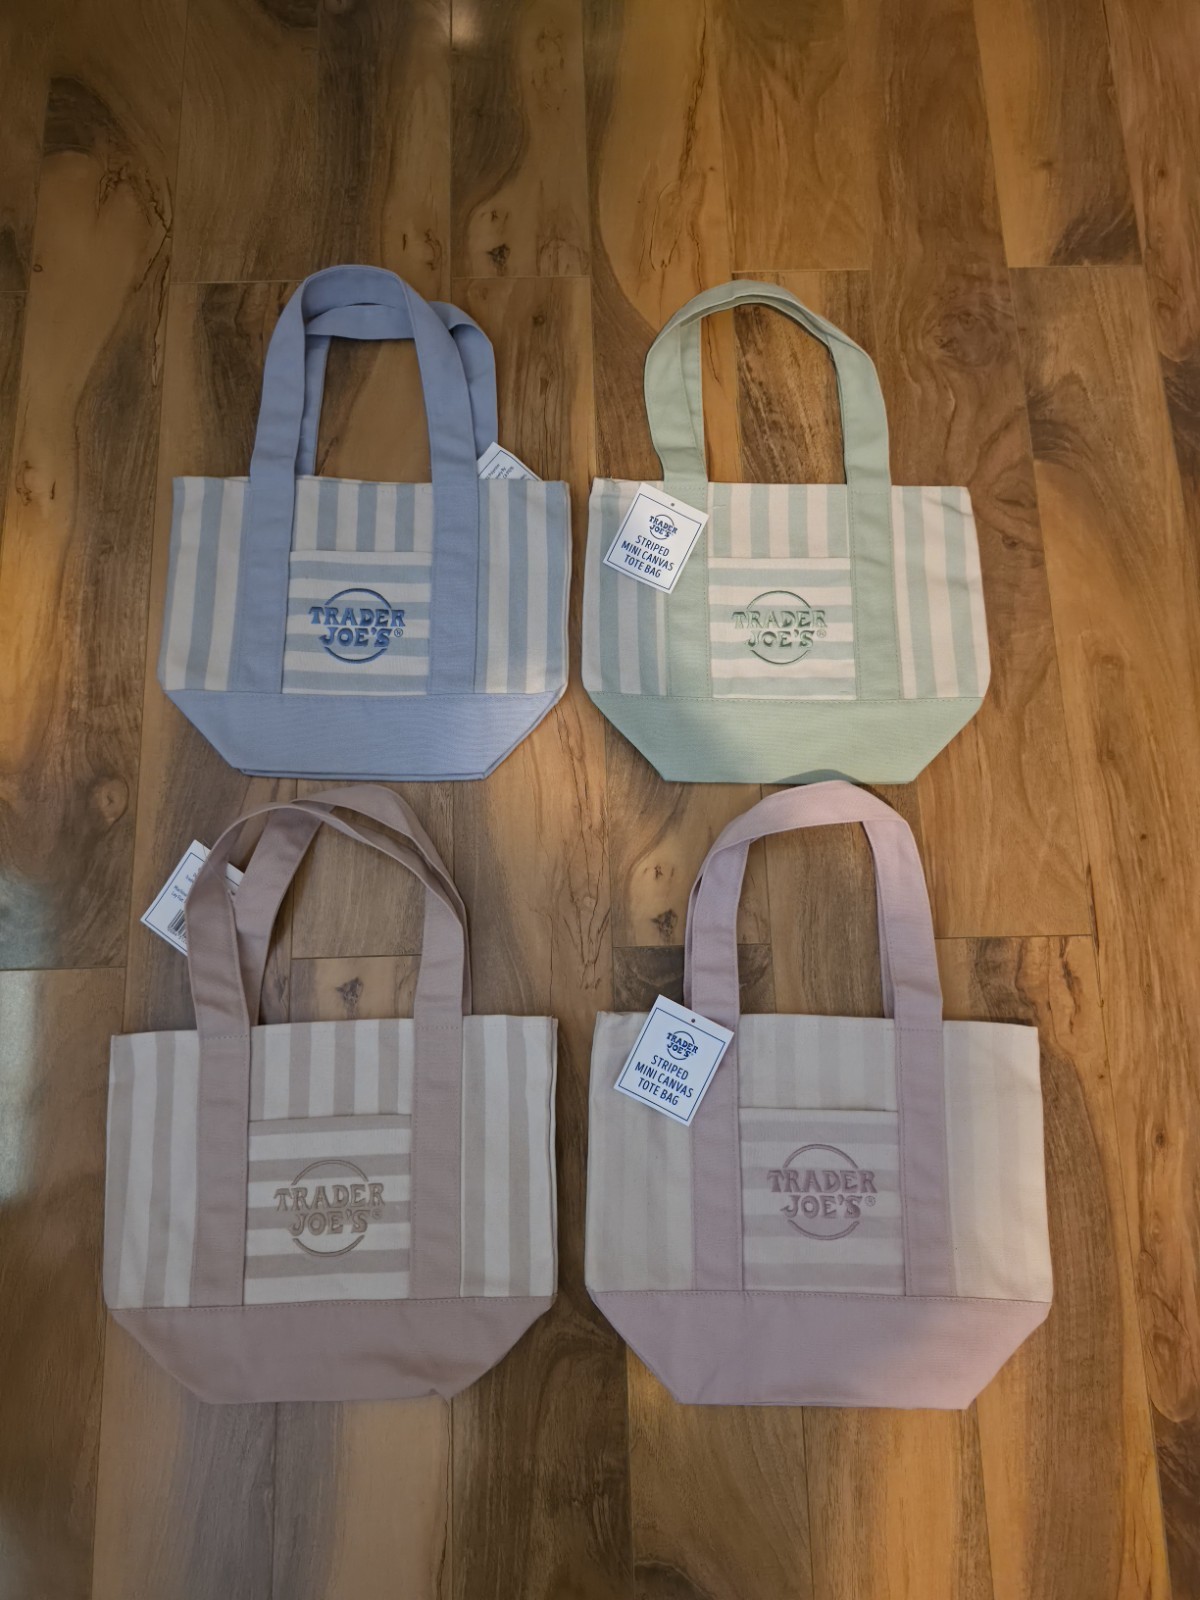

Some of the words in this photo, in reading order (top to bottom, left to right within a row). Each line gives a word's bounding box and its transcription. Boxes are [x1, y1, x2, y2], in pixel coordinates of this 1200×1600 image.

[648, 515, 678, 535] TRADER
[620, 540, 642, 557] MINI
[641, 550, 674, 571] CANVAS
[635, 535, 670, 557] STRIPED
[624, 554, 645, 571] TOTE
[644, 564, 661, 578] BAG
[308, 606, 406, 627] TRADER
[731, 609, 828, 629] TRADER
[666, 1032, 699, 1054] TRADER
[634, 1061, 658, 1080] MINI
[657, 1072, 694, 1098] CANVAS
[650, 1054, 689, 1081] STRIPED
[637, 1077, 661, 1097] TOTE
[659, 1089, 680, 1106] BAG
[766, 1169, 878, 1194] TRADER
[273, 1182, 386, 1211] TRADER
